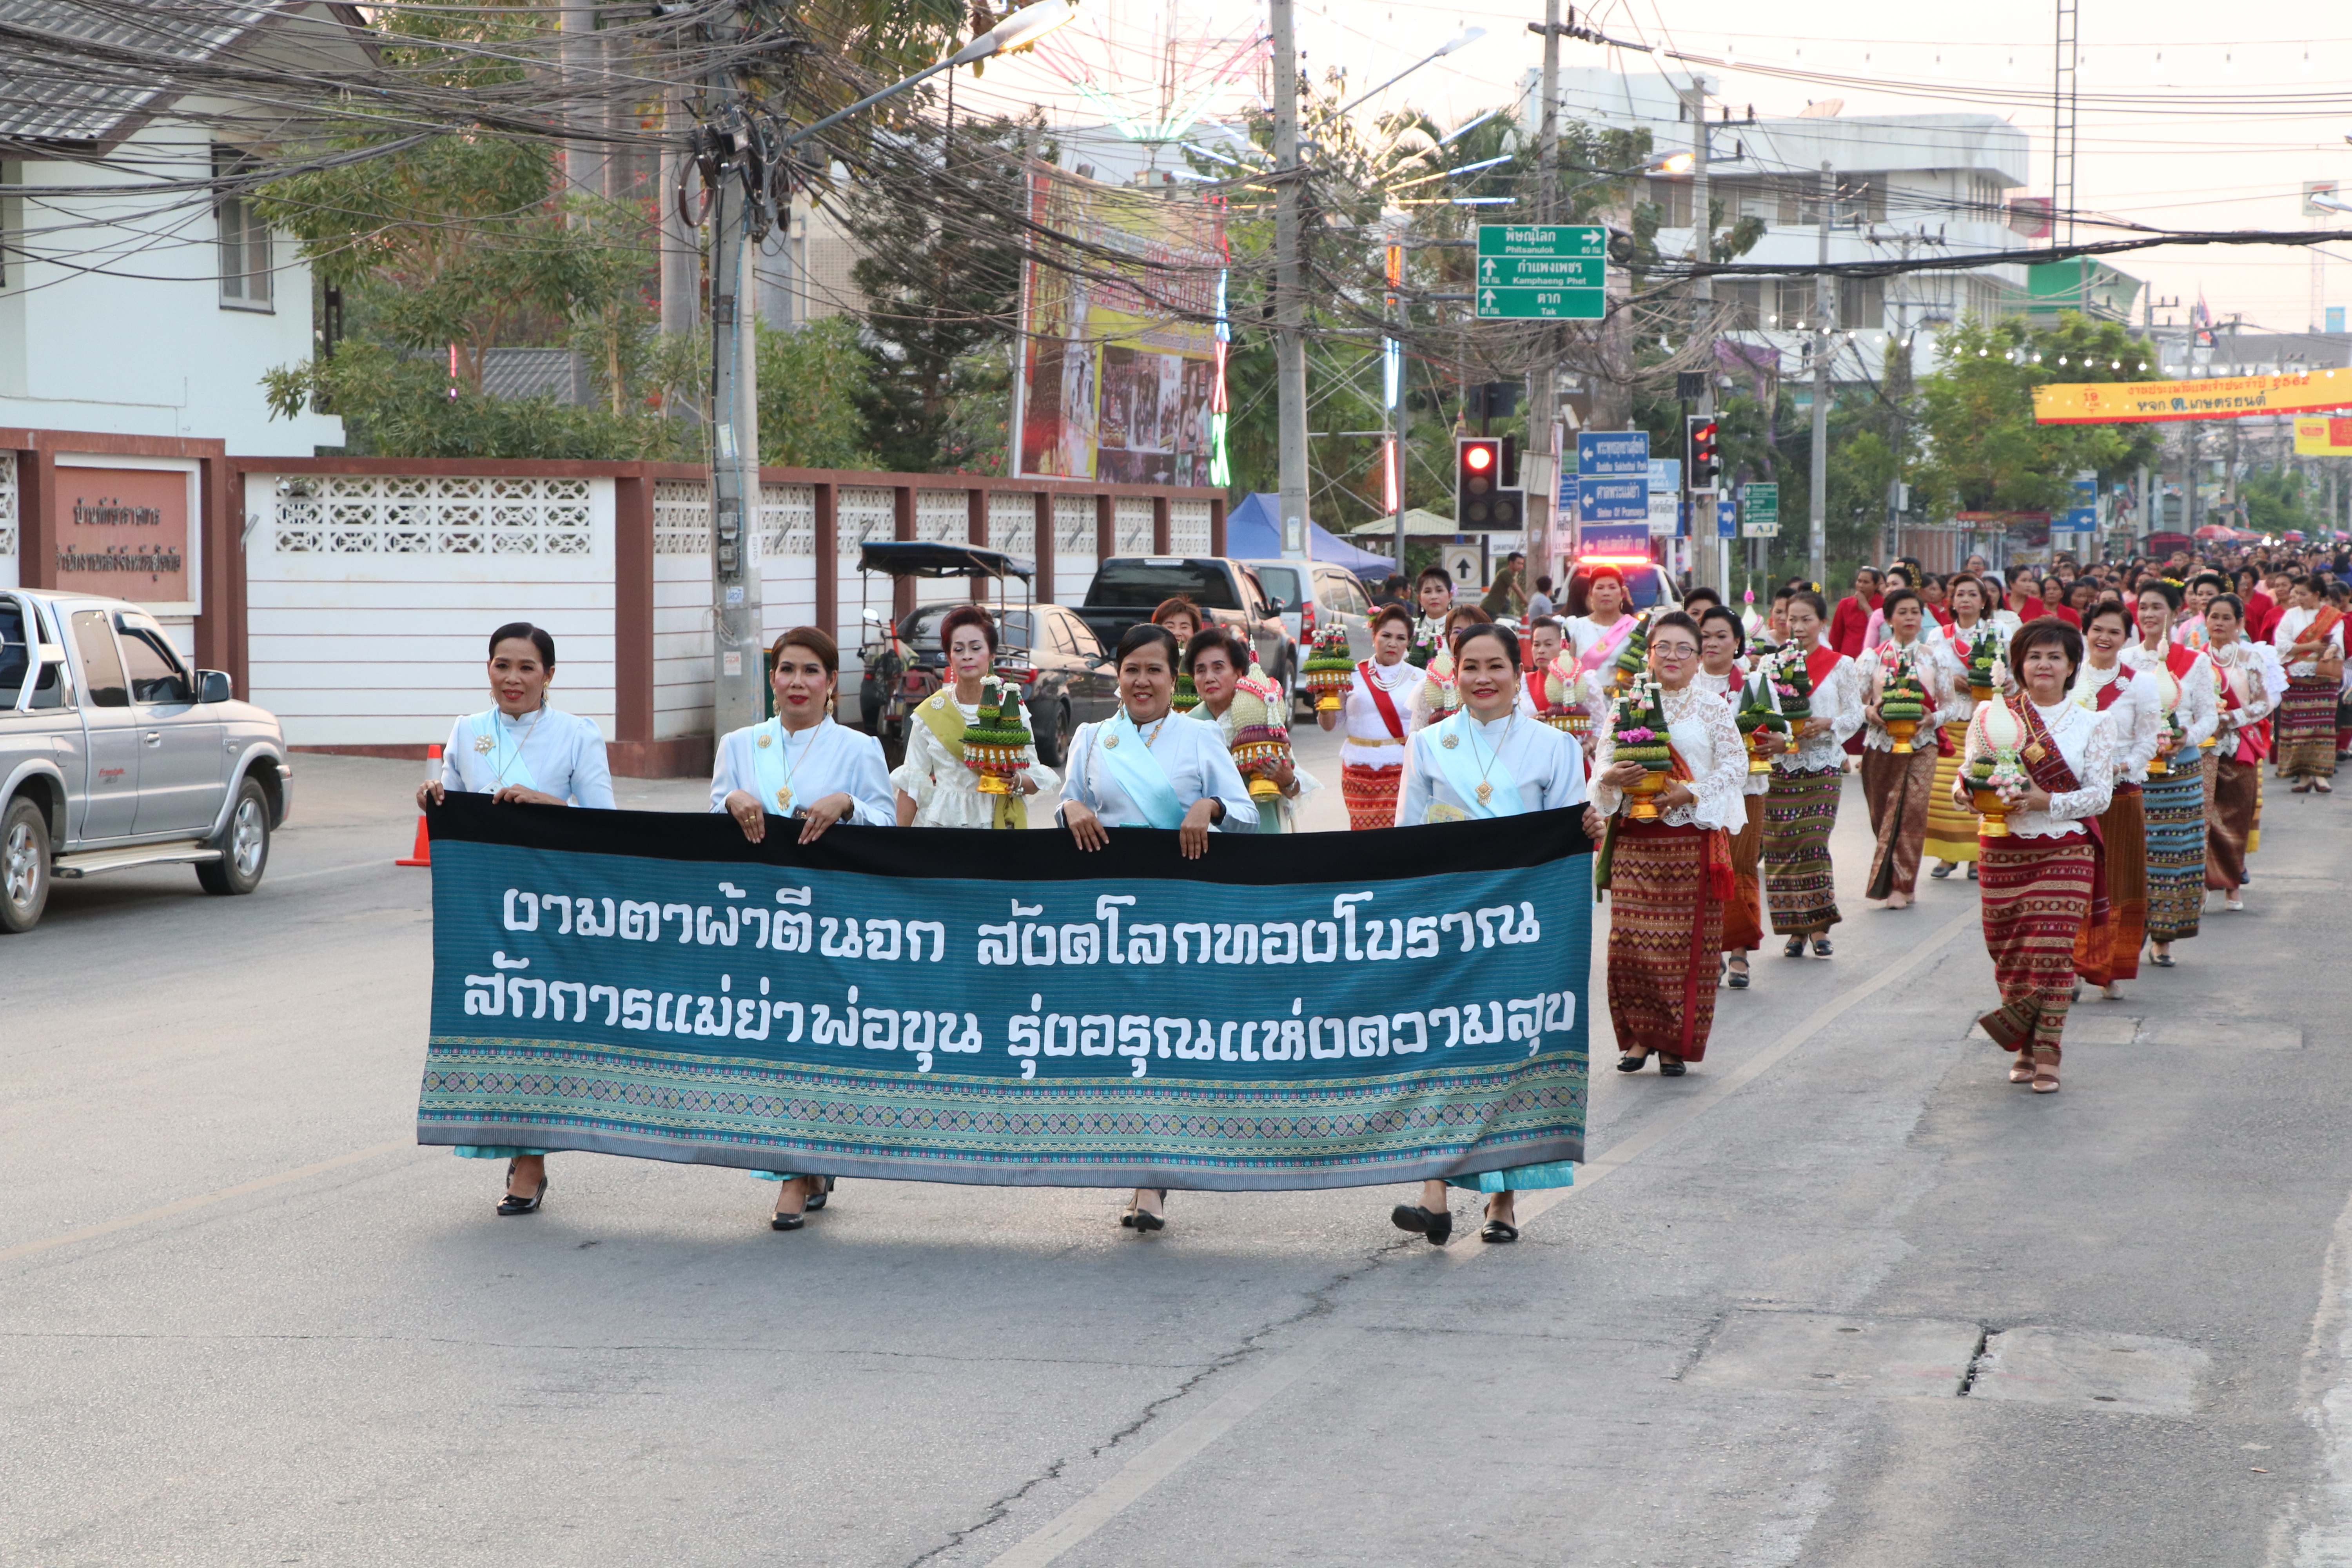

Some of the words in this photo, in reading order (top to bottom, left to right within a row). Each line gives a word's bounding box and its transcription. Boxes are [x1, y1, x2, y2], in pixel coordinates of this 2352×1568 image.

[1506, 227, 1556, 245] พิษณุโลก
[1517, 259, 1582, 273] กำแพงเพชร
[1513, 277, 1564, 286] Kamphaeng
[1537, 293, 1561, 304] ตาก
[2274, 376, 2310, 387] 2562
[504, 883, 945, 962] งามตาผ้าตีนจก
[978, 891, 1540, 965] สังคโลกทองโบราณ
[465, 951, 982, 1073] สักการแม่ย่าพ่อขุน
[1008, 991, 1575, 1080] รุ่งอรุณแห่งความสุข
